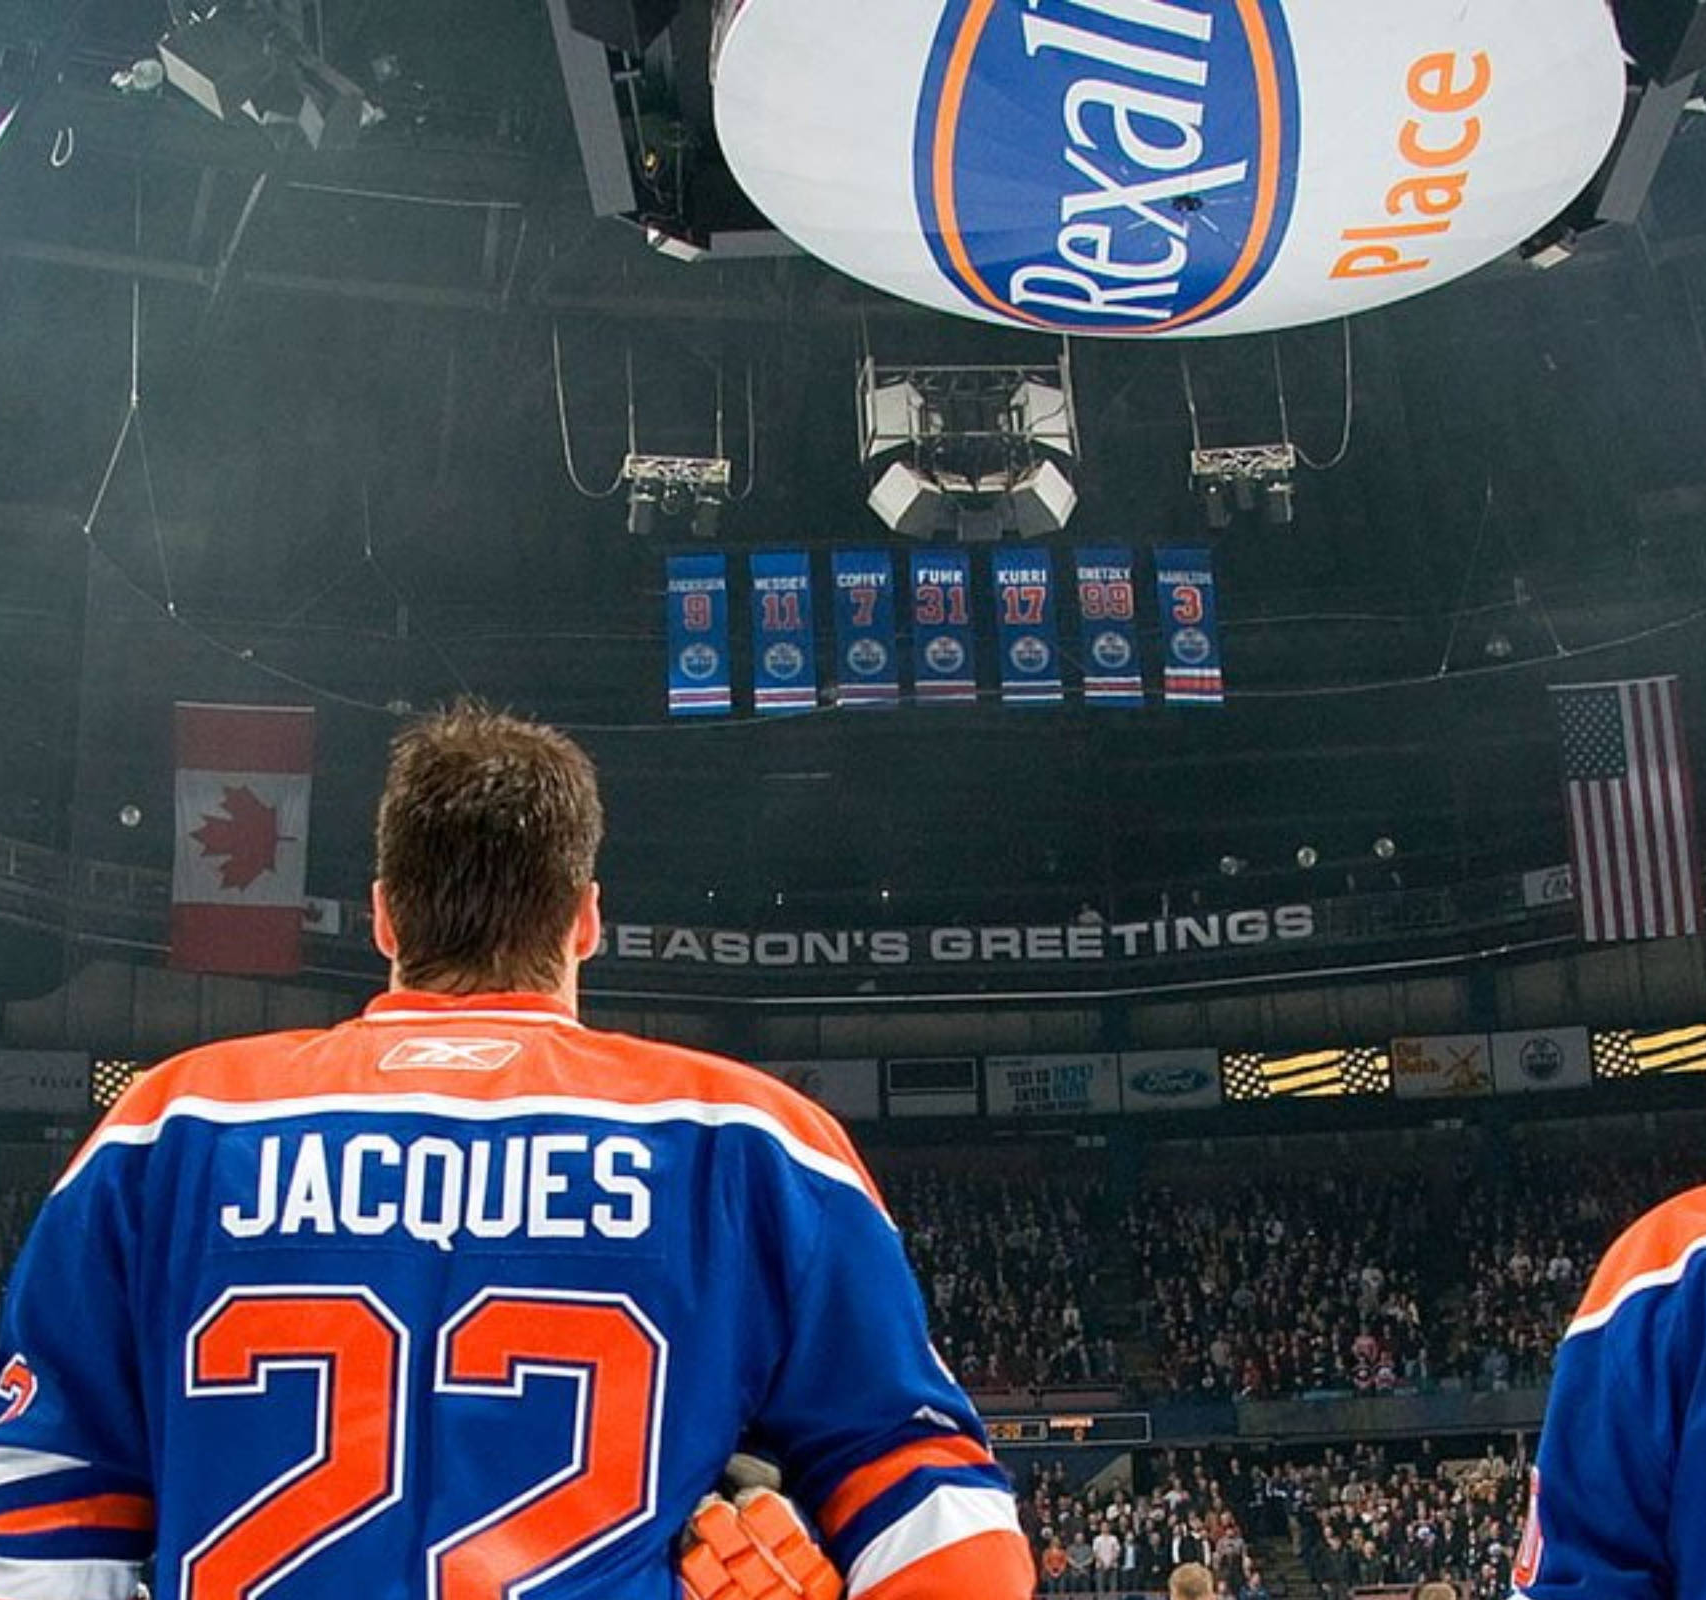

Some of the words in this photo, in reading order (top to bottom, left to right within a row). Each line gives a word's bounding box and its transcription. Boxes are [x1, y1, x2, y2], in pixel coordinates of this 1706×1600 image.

[1328, 50, 1492, 282] Place
[916, 569, 964, 585] FUHR
[997, 569, 1047, 585] KURRI
[682, 592, 712, 631] 9
[762, 591, 802, 631] 11
[849, 587, 878, 627] 7
[915, 585, 969, 625] 31
[1001, 585, 1047, 625] 17
[1171, 585, 1204, 625] 3
[929, 904, 1314, 963] GREETINGS
[220, 1133, 652, 1252] JACQUES
